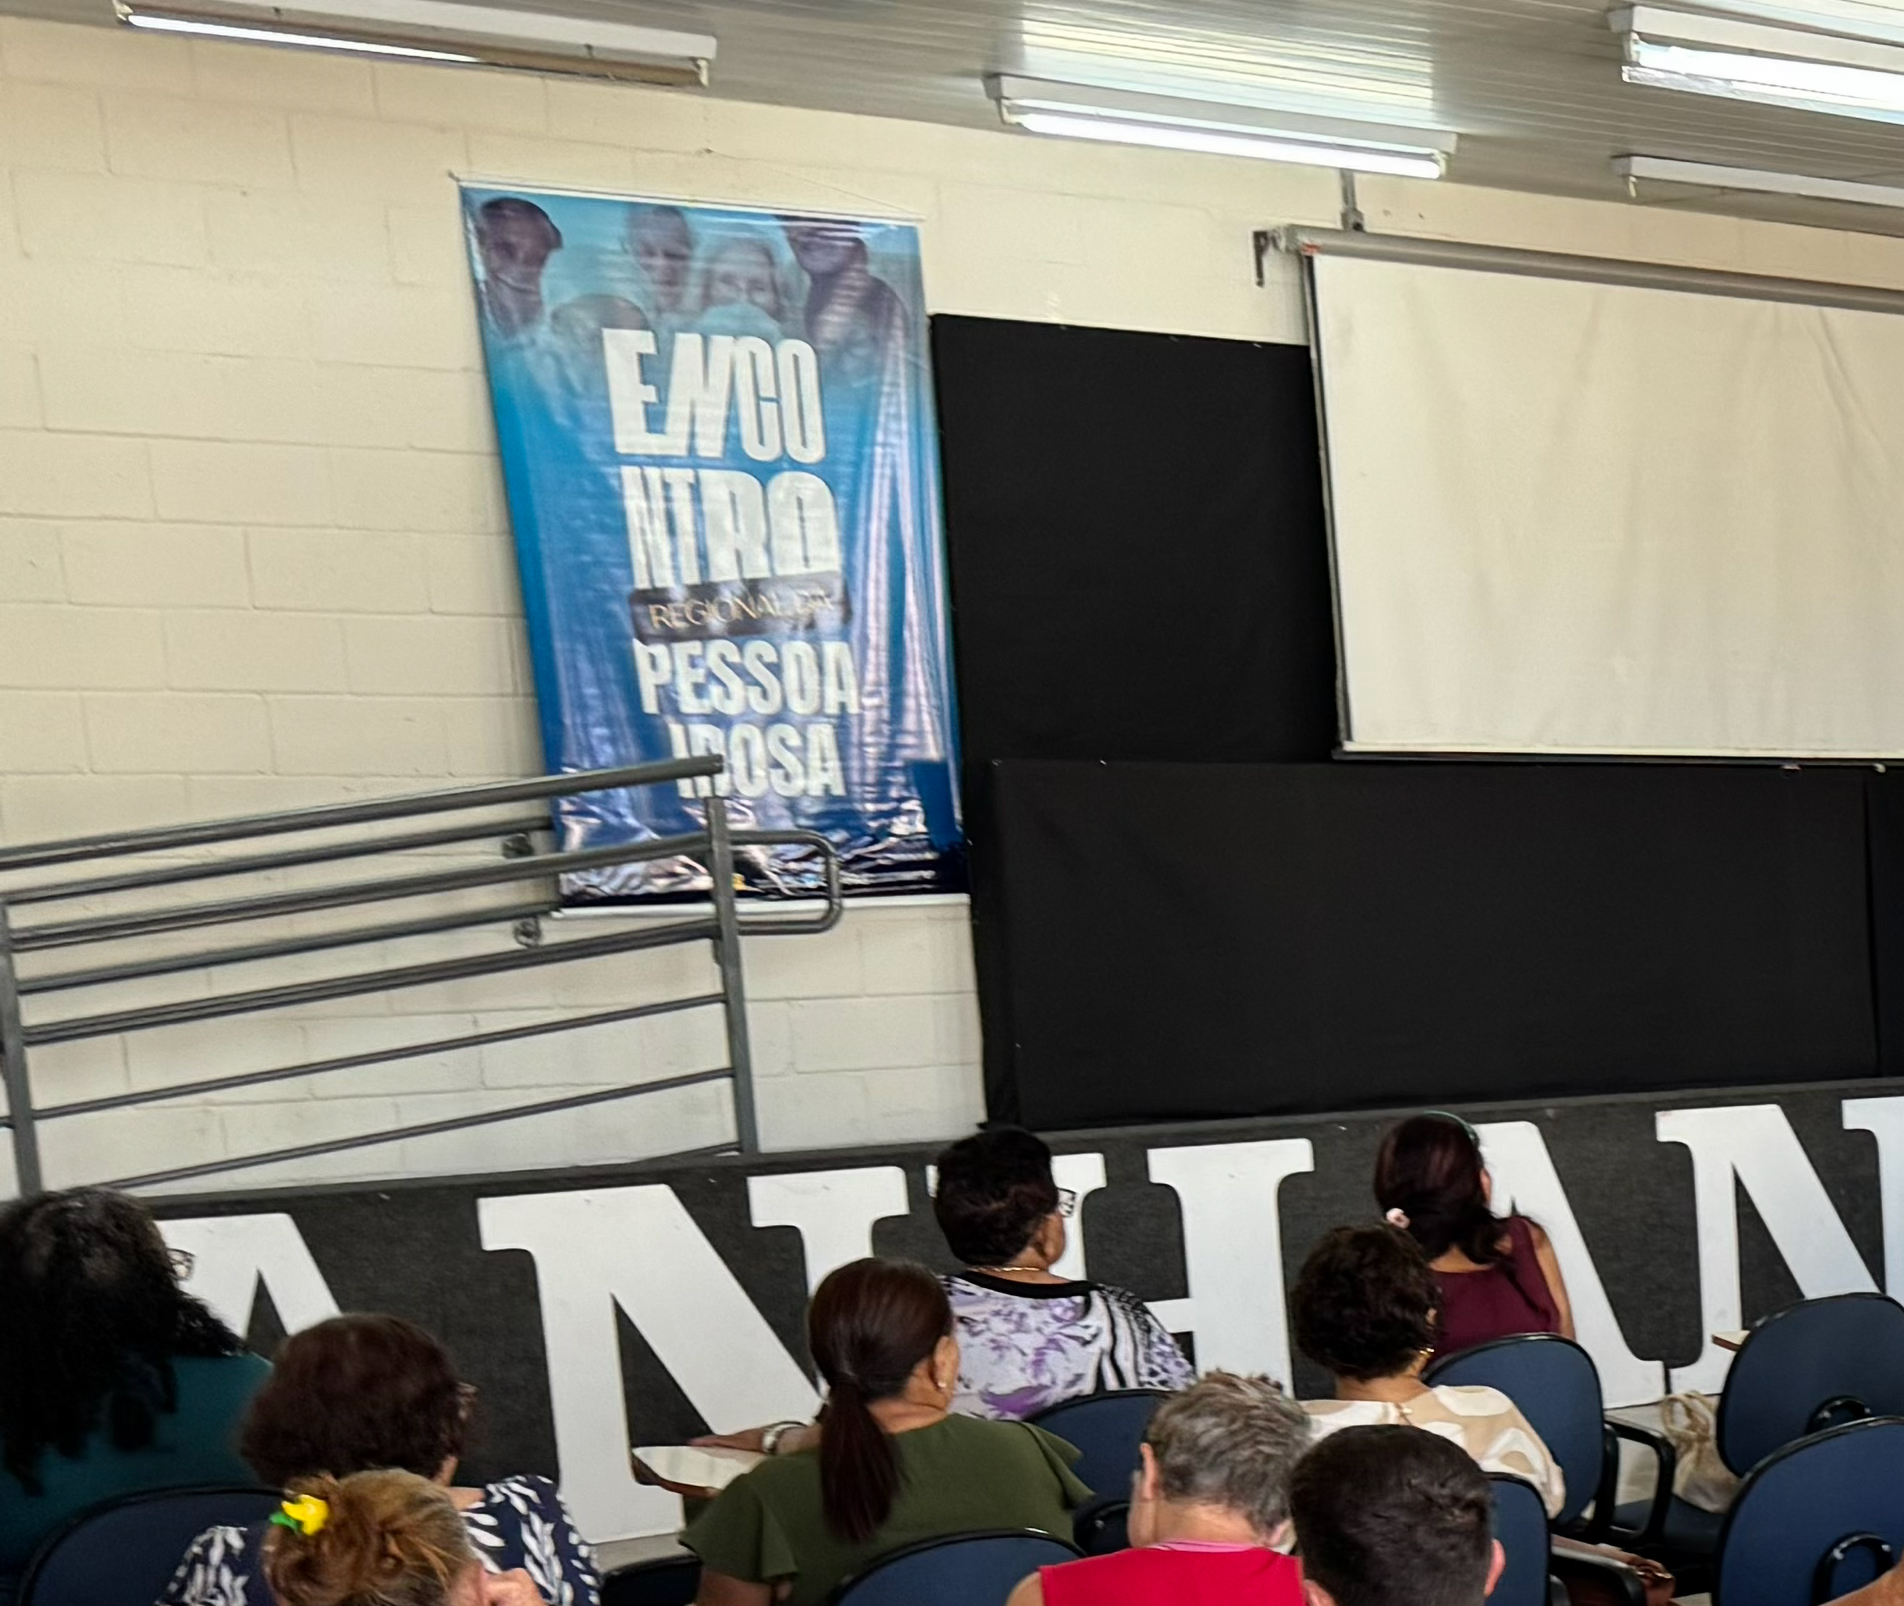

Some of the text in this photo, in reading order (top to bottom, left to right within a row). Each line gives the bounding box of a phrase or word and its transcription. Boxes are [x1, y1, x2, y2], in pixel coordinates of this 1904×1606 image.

[602, 328, 826, 464] ENCO
[620, 465, 842, 589] NTRO
[632, 638, 859, 716] PESSOA
[667, 722, 847, 798] IDOSA
